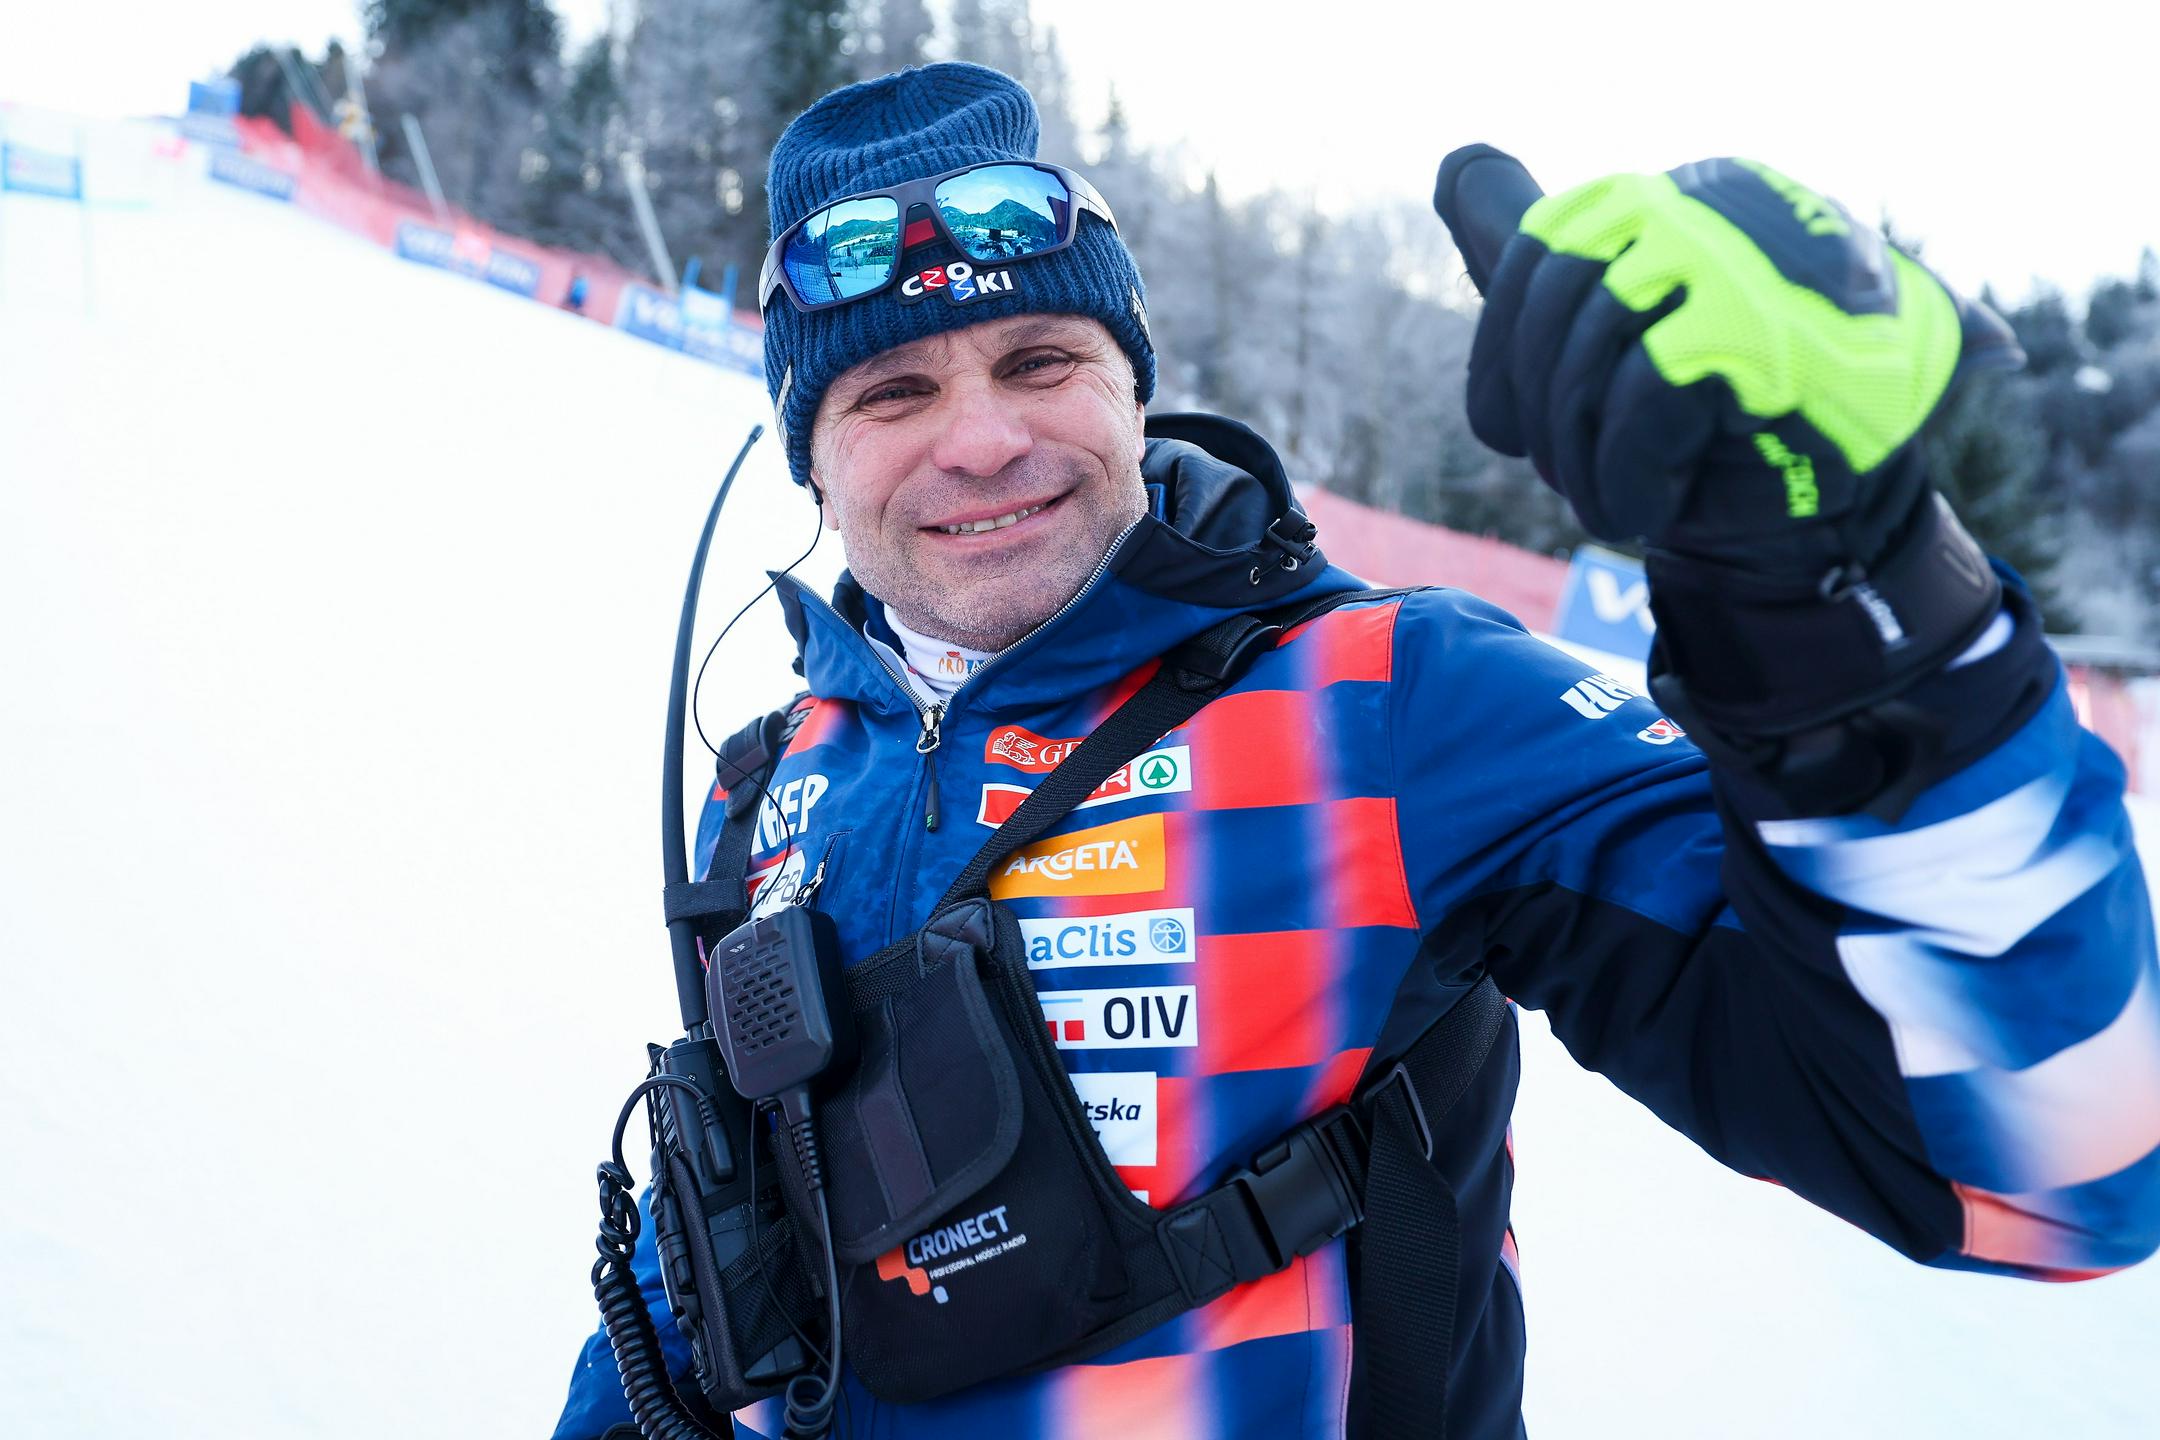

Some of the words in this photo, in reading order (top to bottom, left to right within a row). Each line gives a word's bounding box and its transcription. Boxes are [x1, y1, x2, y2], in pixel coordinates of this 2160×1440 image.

[1004, 840, 1138, 880] ARGETA
[1026, 923, 1136, 962] aClis
[1103, 994, 1189, 1040] OIV
[1083, 1097, 1141, 1121] tska
[908, 1205, 1009, 1264] CRONECT
